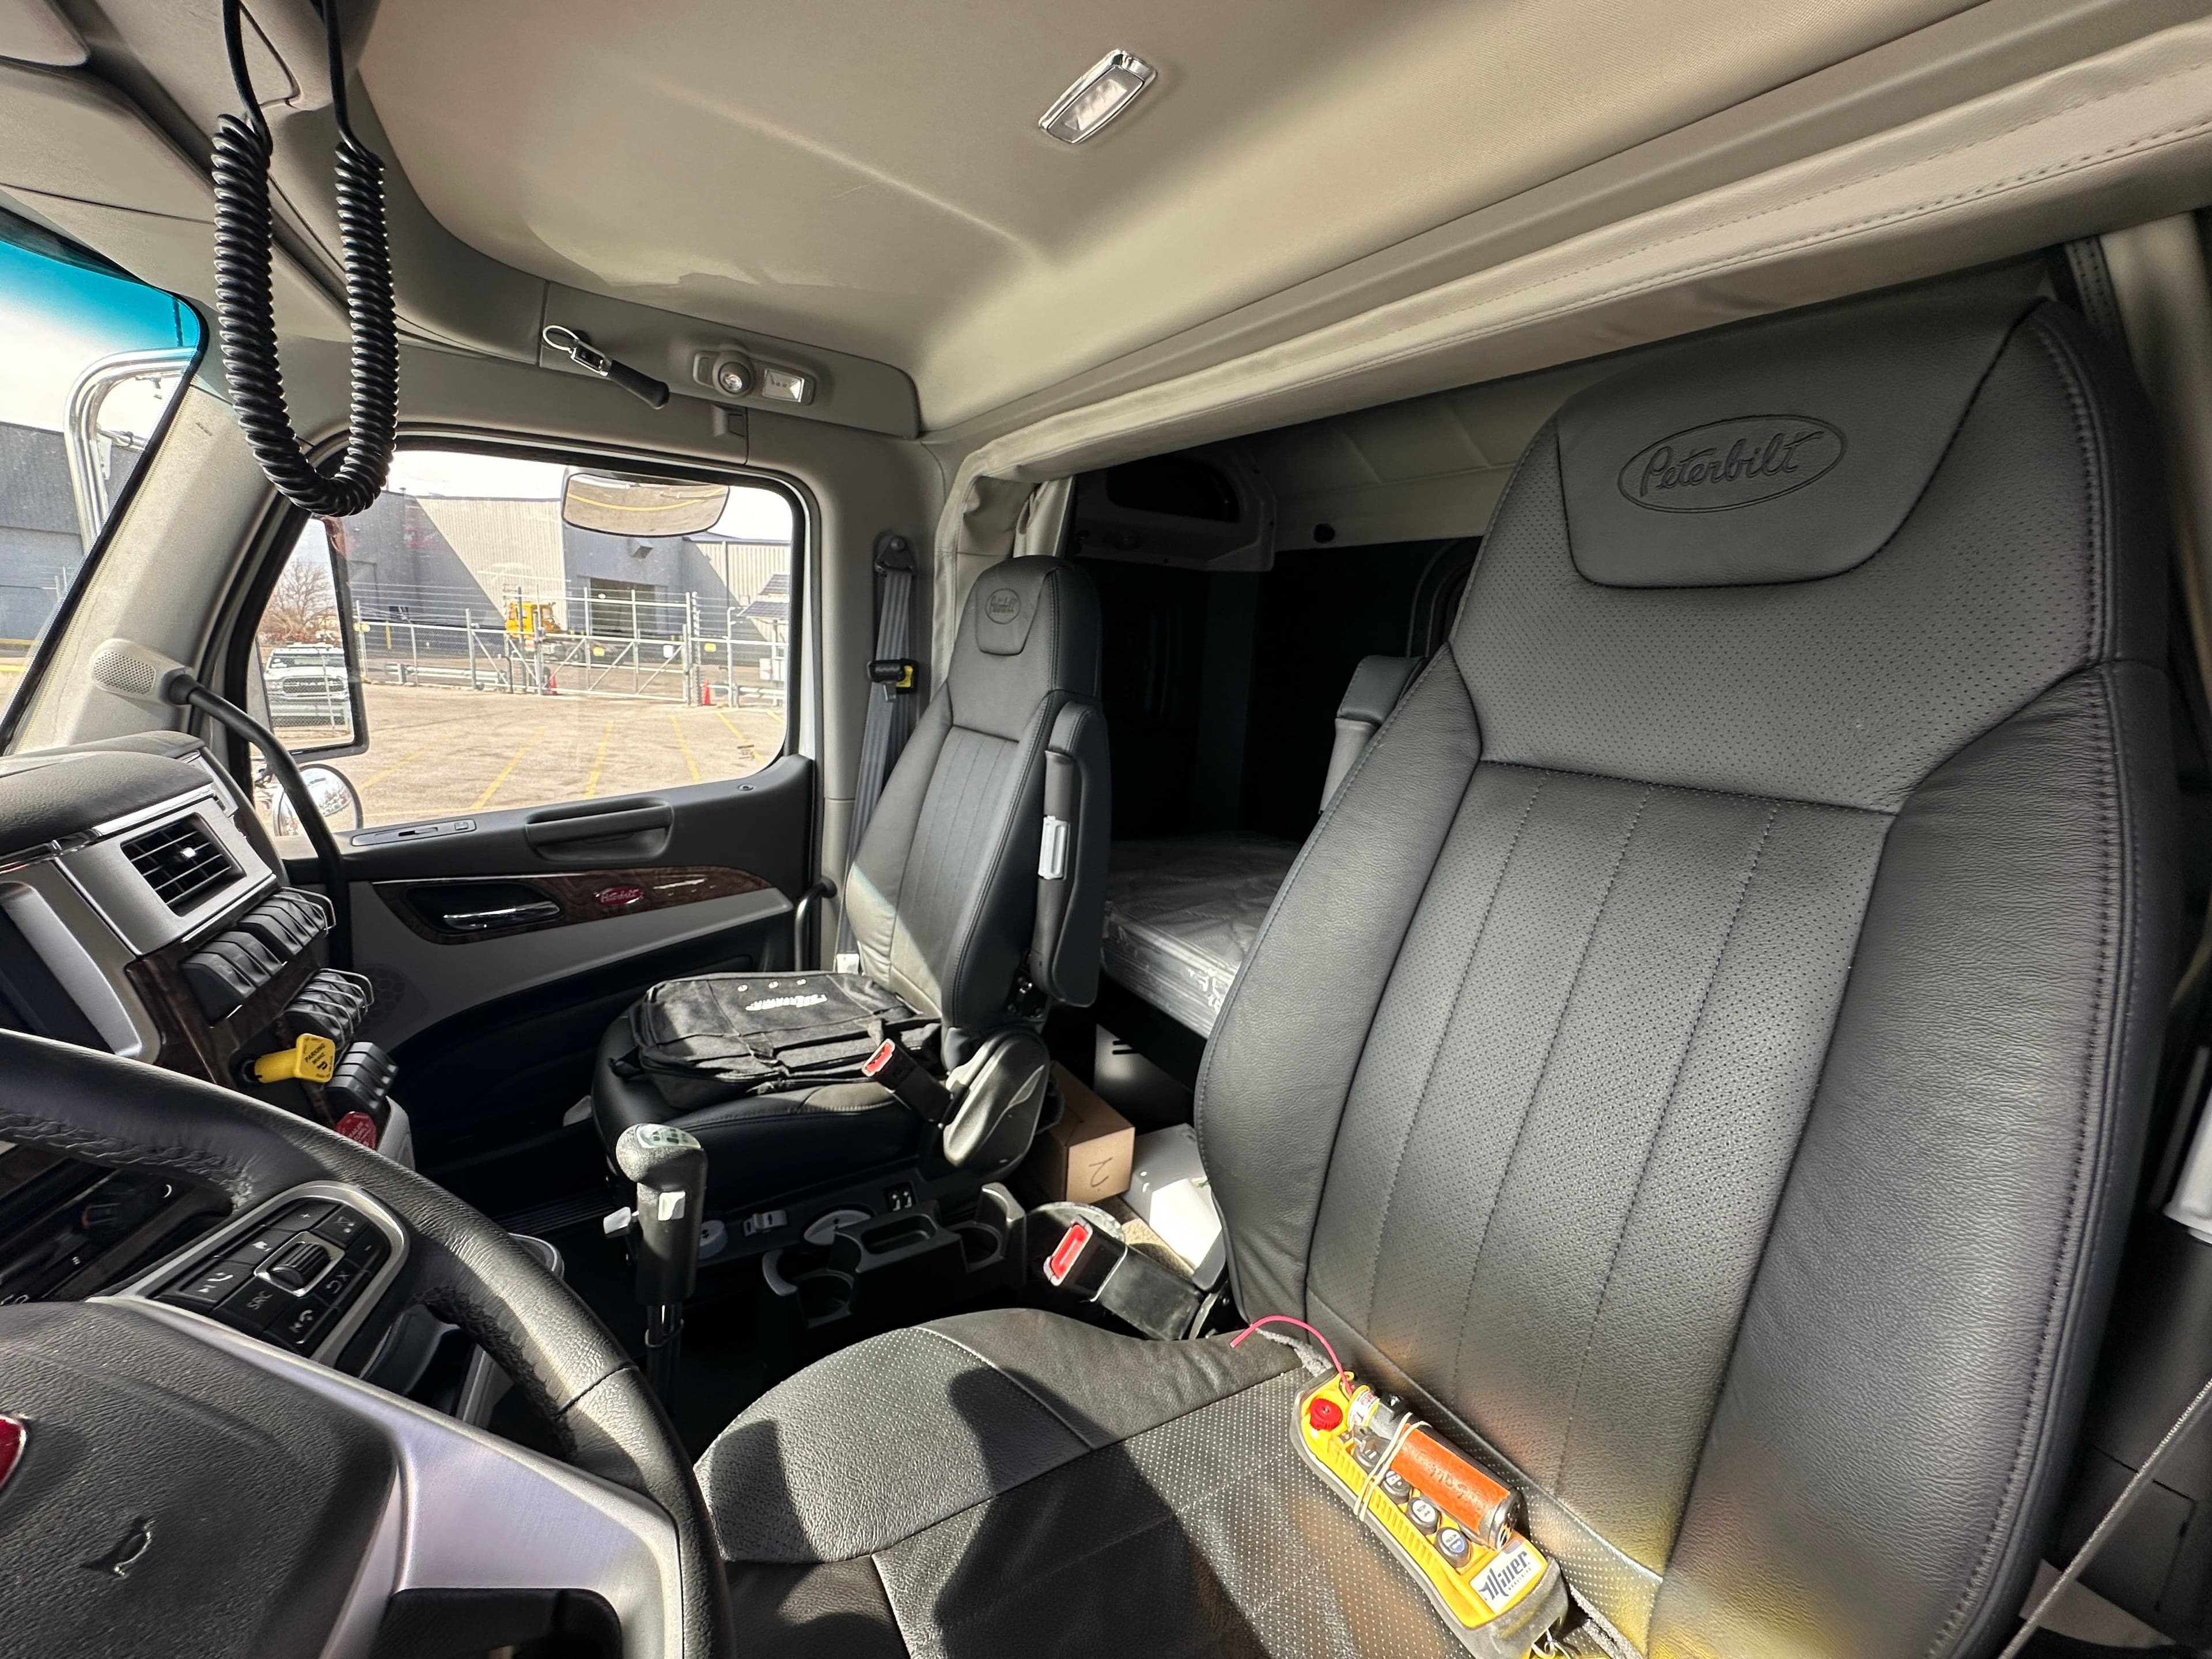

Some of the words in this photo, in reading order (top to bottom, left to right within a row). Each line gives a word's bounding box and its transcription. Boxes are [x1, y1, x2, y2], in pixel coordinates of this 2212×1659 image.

[1639, 431, 1825, 498] Peterbilt
[304, 1043, 325, 1063] PARKING
[247, 1290, 272, 1310] SRC
[1478, 1550, 1528, 1600] Miller
